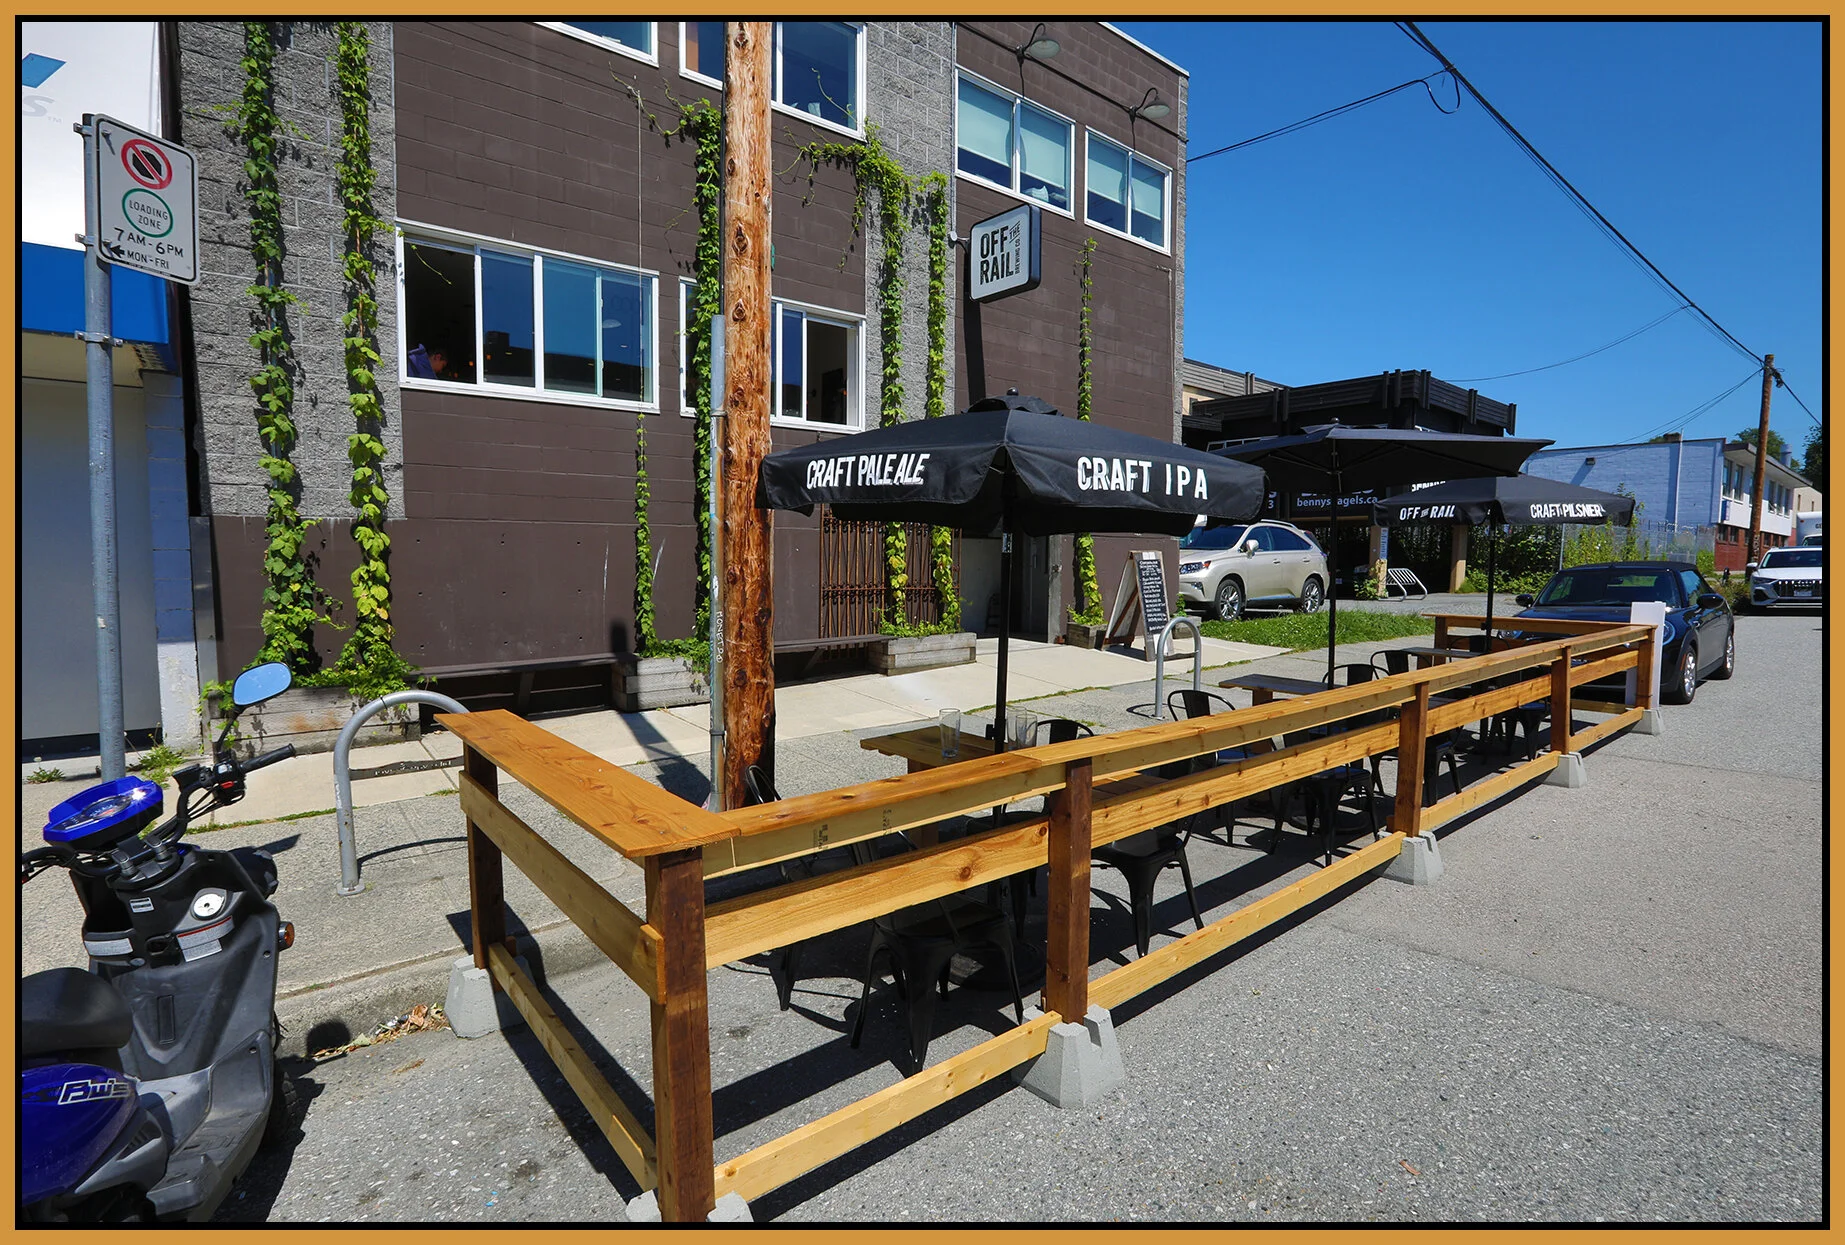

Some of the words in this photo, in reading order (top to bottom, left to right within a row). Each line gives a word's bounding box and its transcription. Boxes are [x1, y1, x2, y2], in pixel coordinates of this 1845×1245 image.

[128, 199, 169, 221] LOADING
[138, 215, 162, 230] ZONE
[980, 225, 1009, 259] OFF
[1009, 223, 1021, 240] THE
[980, 251, 1014, 286] RAIL
[806, 455, 856, 490] CRAFT
[857, 453, 898, 487] PALE
[893, 453, 931, 486] ALE
[1077, 456, 1153, 494] CRAFT
[1165, 463, 1208, 500] IPA
[1296, 495, 1378, 508] bennysagels.ca
[1530, 503, 1561, 519] CRAFT
[1562, 503, 1603, 518] PILSNER
[1399, 507, 1421, 521] OFF
[1430, 505, 1456, 519] RAIL
